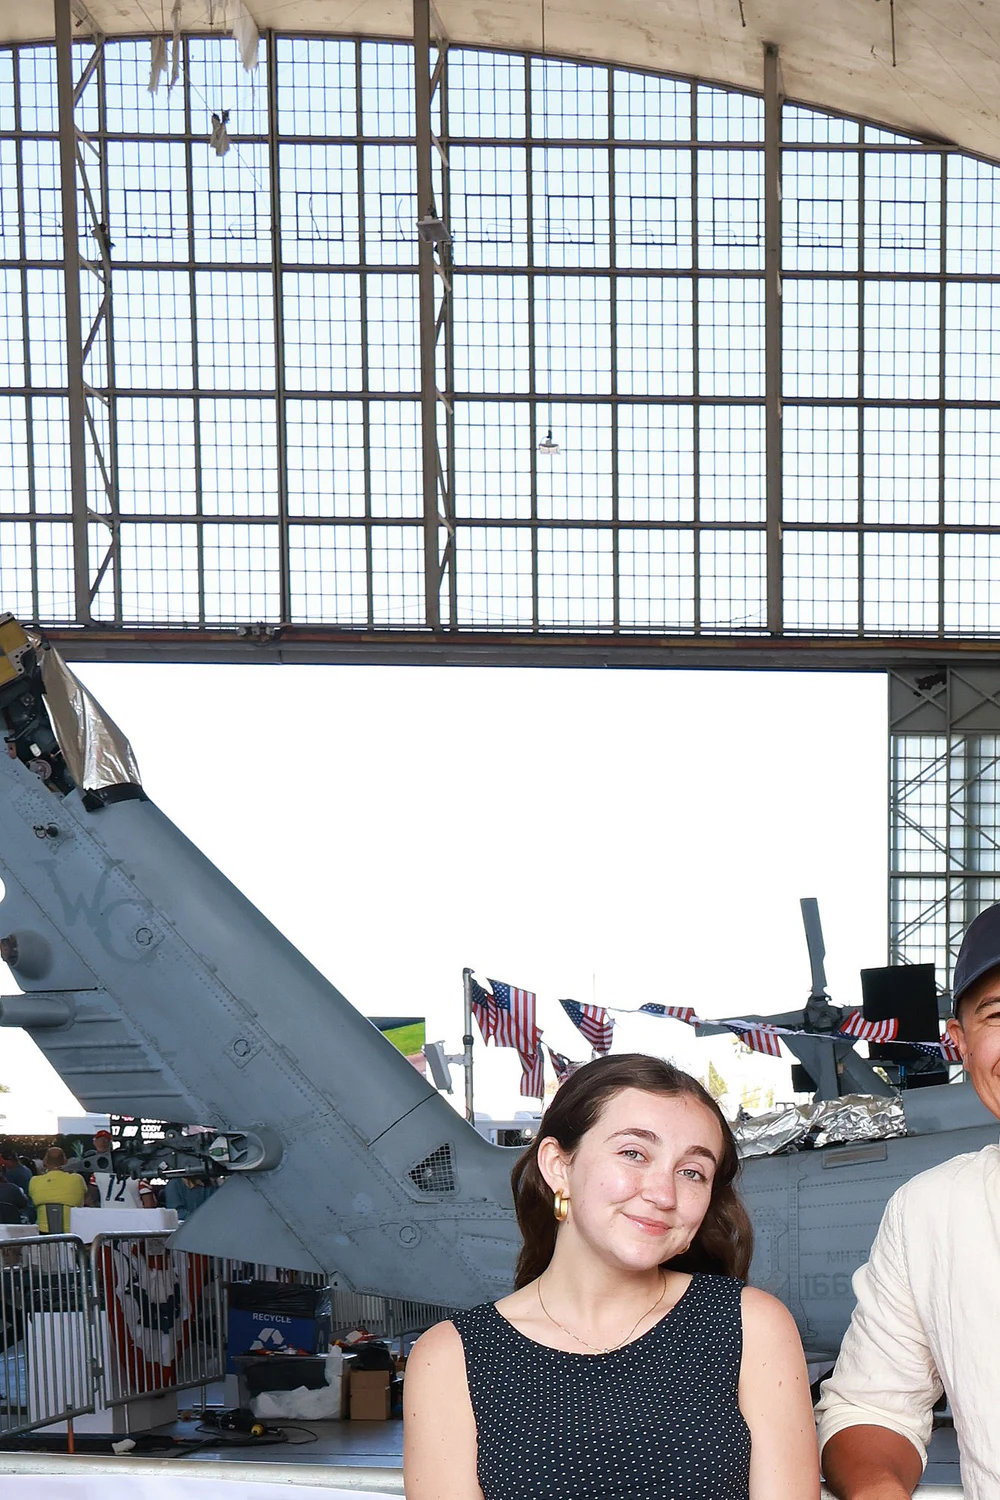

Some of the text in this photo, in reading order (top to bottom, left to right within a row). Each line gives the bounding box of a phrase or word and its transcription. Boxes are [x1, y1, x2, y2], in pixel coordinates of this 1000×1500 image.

[112, 1125, 121, 1136] 17
[140, 1124, 162, 1132] CODY
[252, 1311, 292, 1324] RECYCLE
